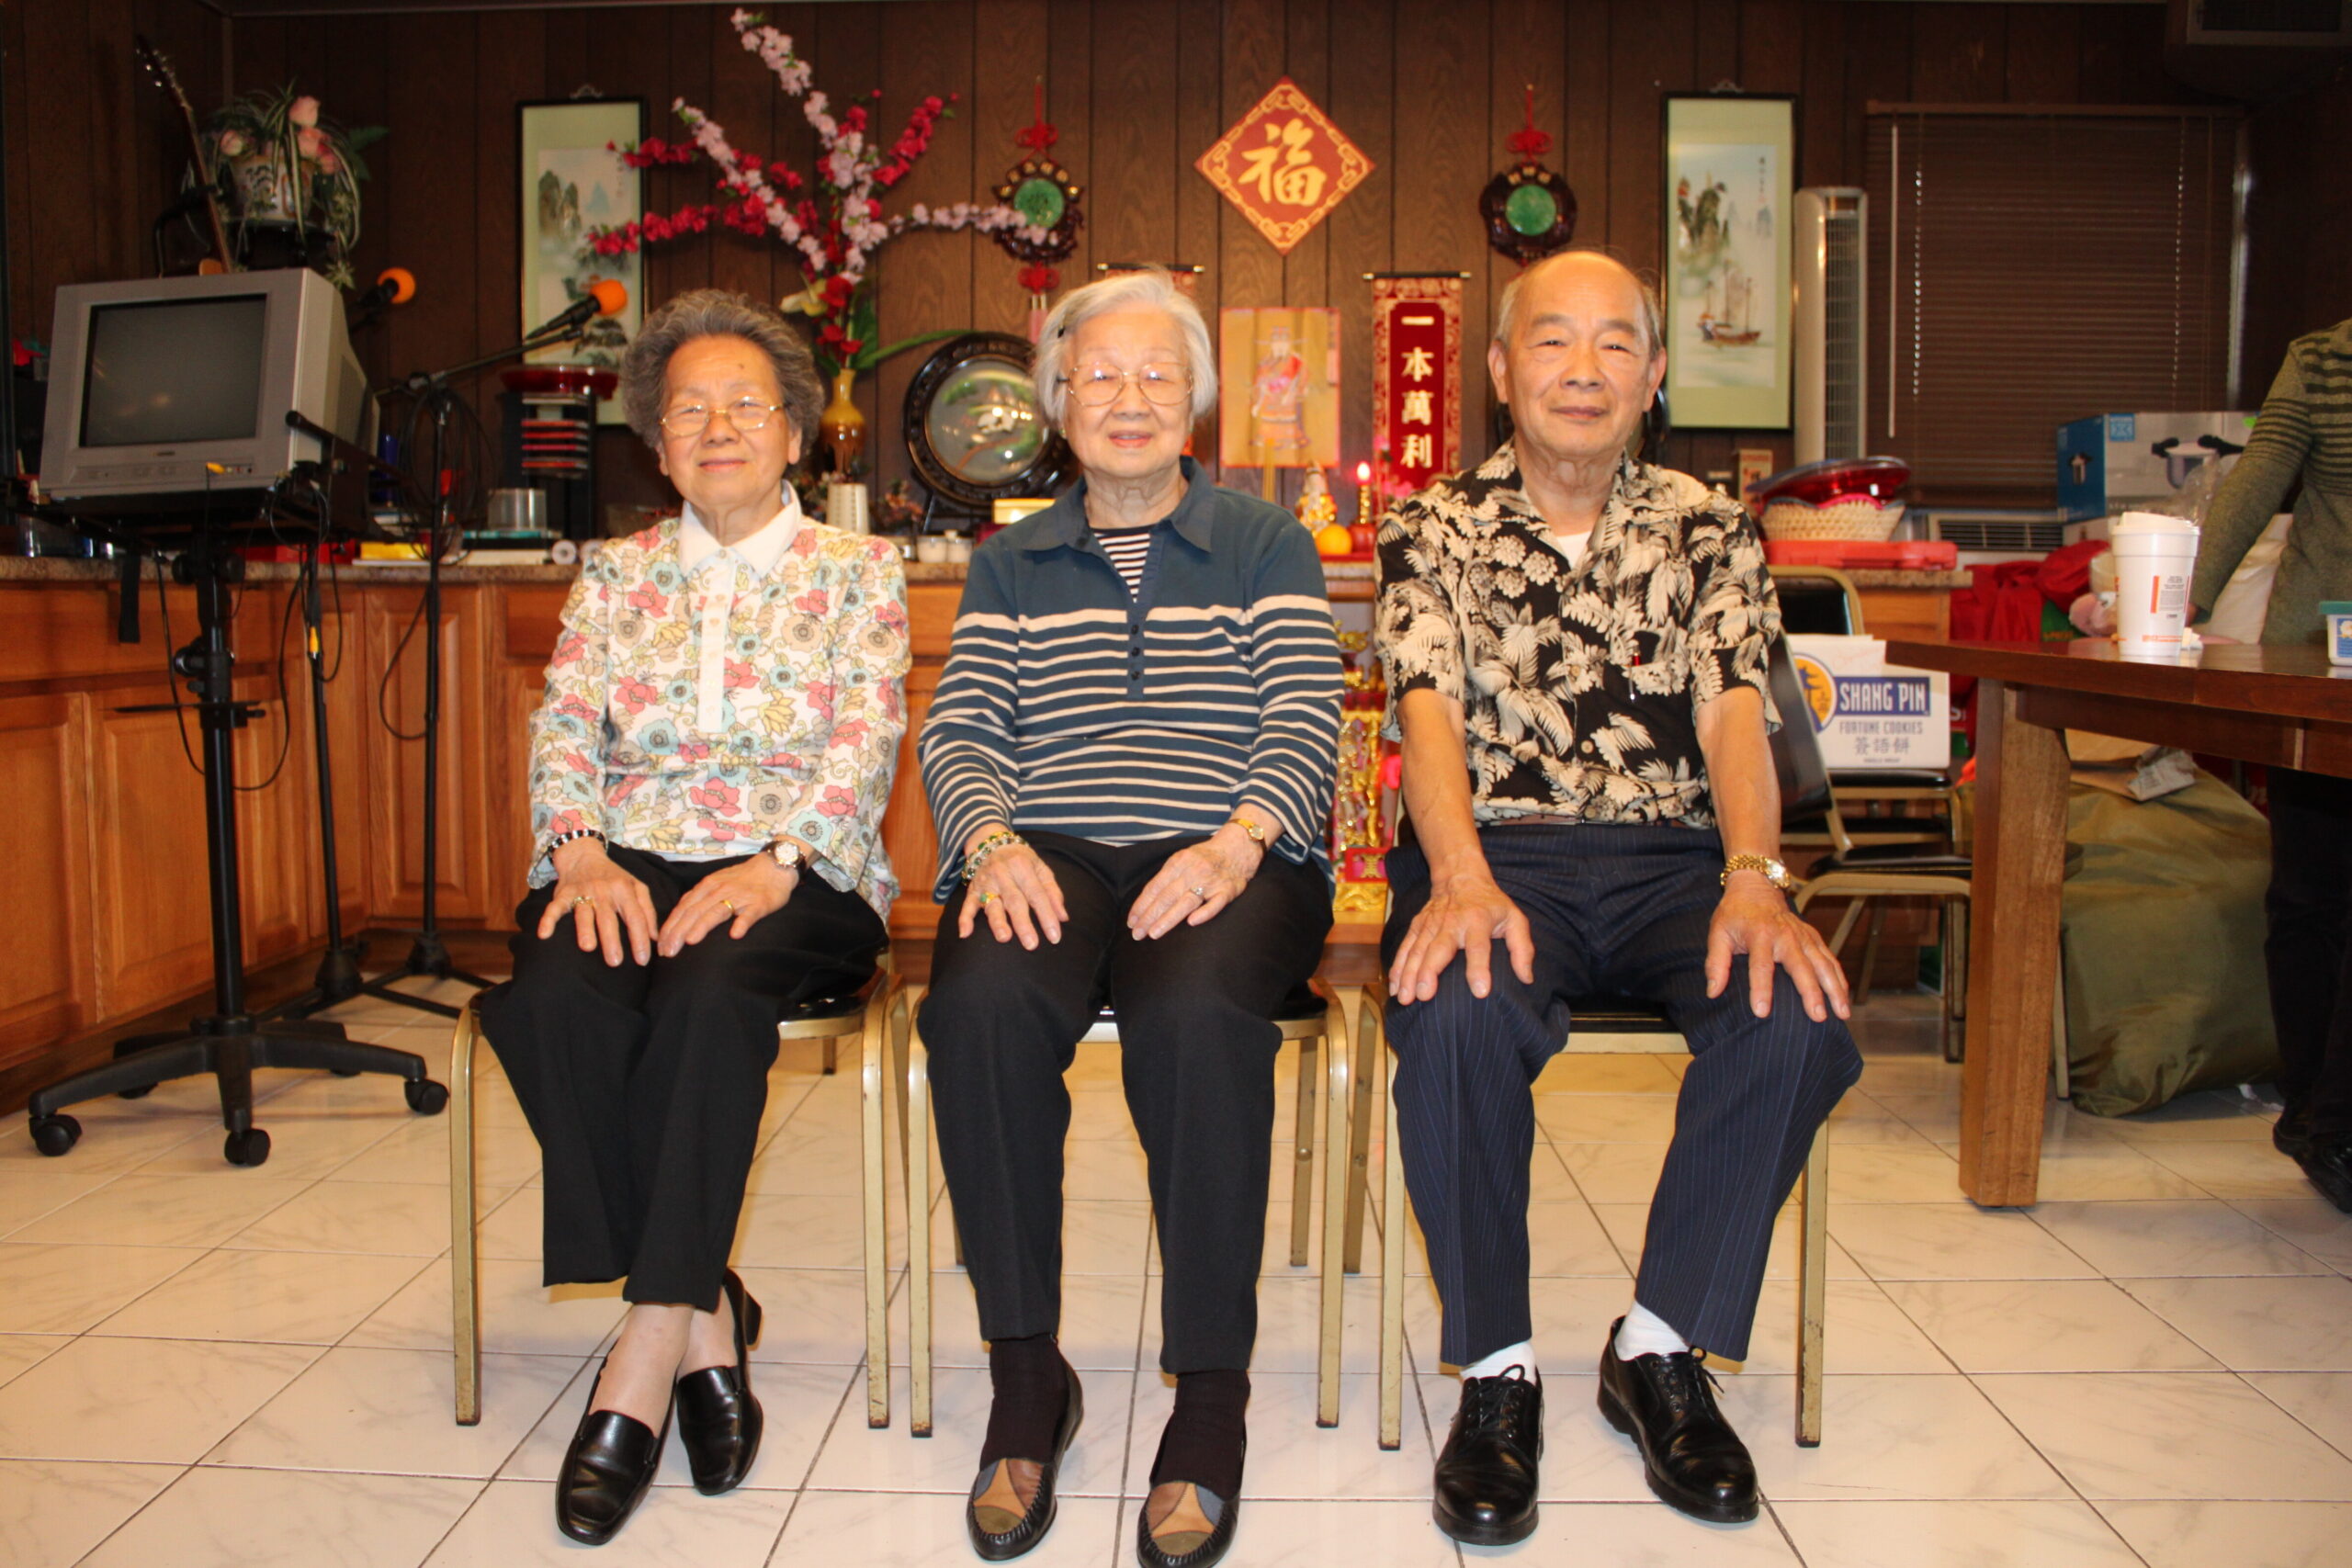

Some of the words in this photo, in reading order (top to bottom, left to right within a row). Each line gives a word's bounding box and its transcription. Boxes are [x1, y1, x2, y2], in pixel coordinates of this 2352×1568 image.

[1238, 118, 1328, 207] 福
[1400, 316, 1434, 468] 一本萬利
[1839, 682, 1894, 712] SHANG
[1898, 682, 1927, 712] PIN
[1839, 721, 1880, 734] FORTUNE
[1883, 721, 1923, 734] COOKIES
